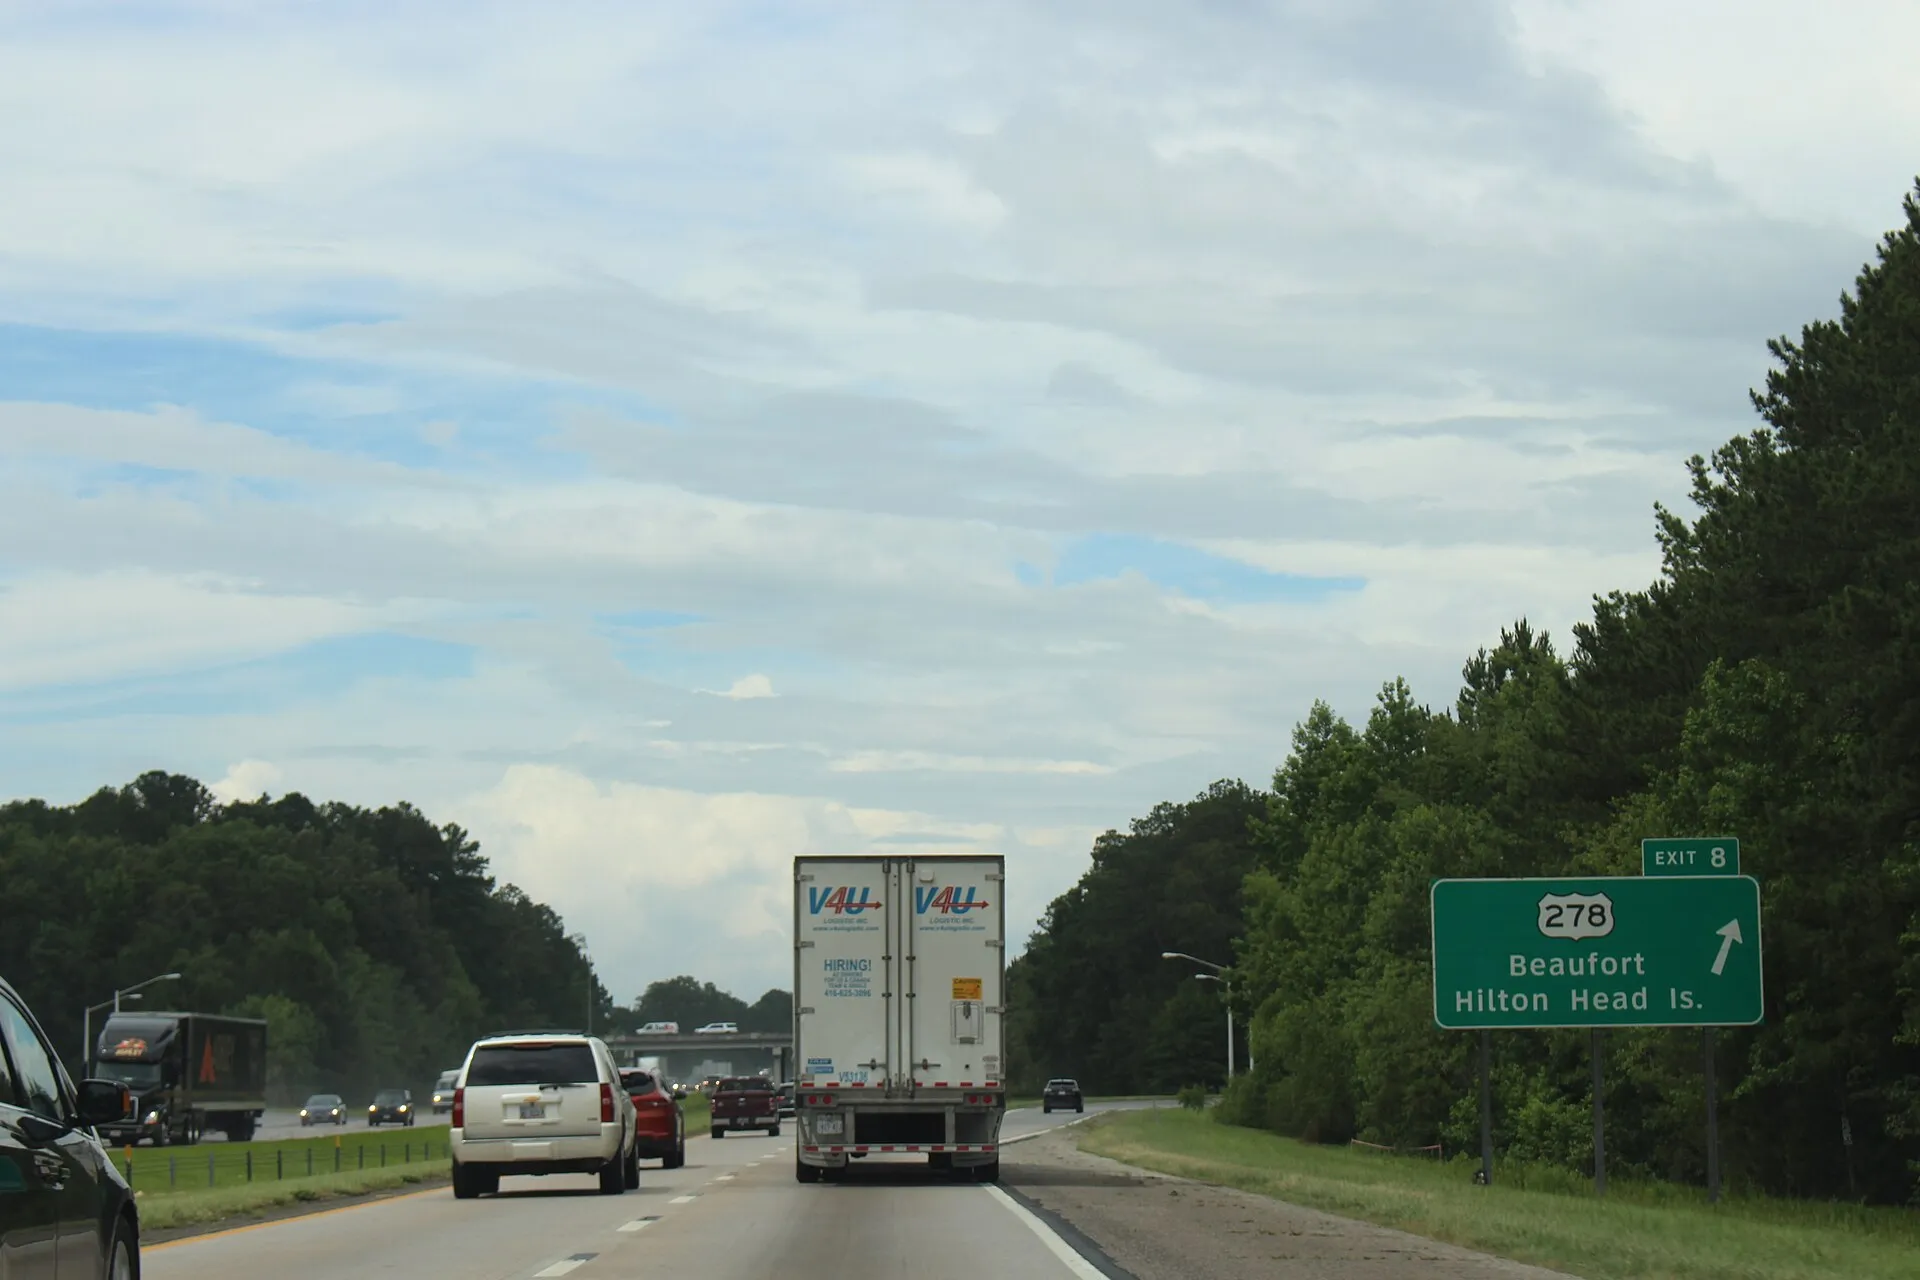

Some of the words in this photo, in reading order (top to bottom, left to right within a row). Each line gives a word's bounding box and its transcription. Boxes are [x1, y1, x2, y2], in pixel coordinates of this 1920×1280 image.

[1655, 851, 1697, 866] EXIT
[1710, 847, 1726, 868] 8
[809, 886, 872, 915] V4U
[915, 886, 979, 915] V4U
[1545, 903, 1607, 928] 278
[824, 959, 872, 972] HIRING!
[1509, 952, 1646, 977] Beaufort
[1455, 988, 1549, 1012] Hilton
[1571, 987, 1648, 1011] Head
[1670, 987, 1704, 1010] Is.
